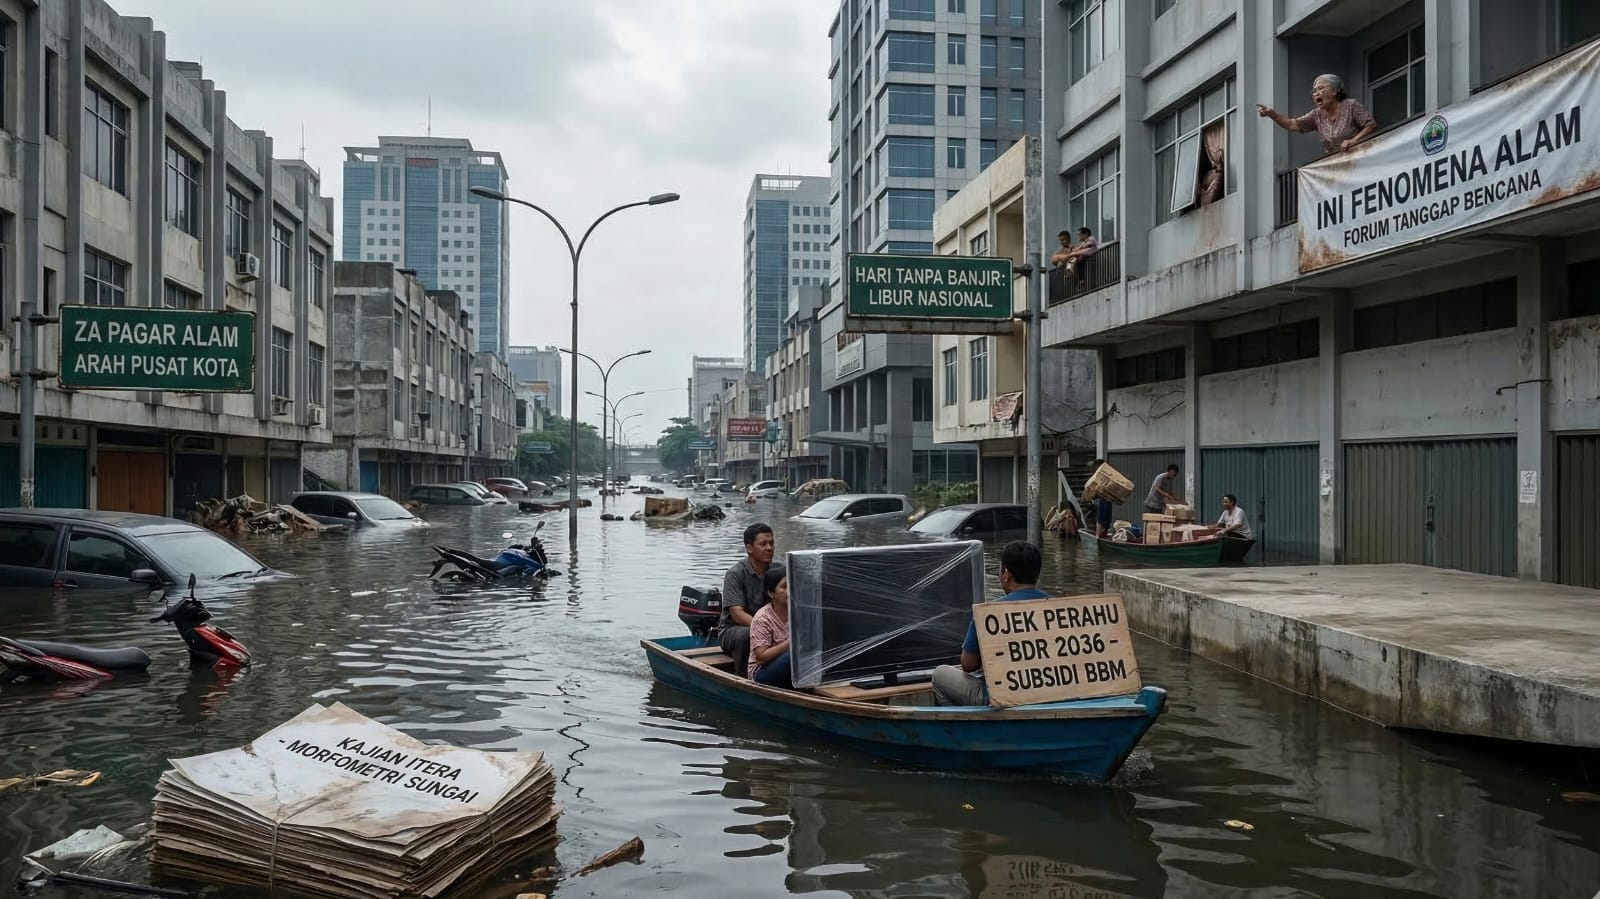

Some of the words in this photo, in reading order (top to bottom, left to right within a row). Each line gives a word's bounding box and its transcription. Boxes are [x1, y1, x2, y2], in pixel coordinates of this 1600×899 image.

[1316, 194, 1344, 230] INI
[1351, 144, 1488, 220] FENOMENA
[1494, 105, 1581, 171] ALAM
[1343, 218, 1390, 248] FORUM
[1392, 196, 1460, 233] TANGGAP
[1464, 169, 1542, 211] BENCANA
[855, 266, 891, 284] HARI
[896, 267, 943, 285] TANPA
[948, 269, 1006, 287] BANJIR:
[869, 288, 913, 306] LIBUR
[918, 291, 993, 308] NASIONAL
[74, 320, 101, 342] ZA
[108, 322, 176, 346] PAGAR
[181, 325, 239, 348] ALAM
[74, 353, 125, 375] ARAH
[131, 355, 188, 376] PUSAT
[193, 357, 240, 378] KOTA
[984, 610, 1039, 636] OJEK
[1043, 603, 1119, 631] PERAHU
[1008, 638, 1050, 662] BDR
[1054, 633, 1105, 657] 2036
[1006, 663, 1079, 691] SUBSIDI
[1084, 659, 1127, 683] BBM
[286, 739, 405, 785] MORFOMETRI
[403, 776, 479, 804] SUNGAI
[336, 737, 408, 766] KAJIAN
[405, 757, 462, 781] ITERA
